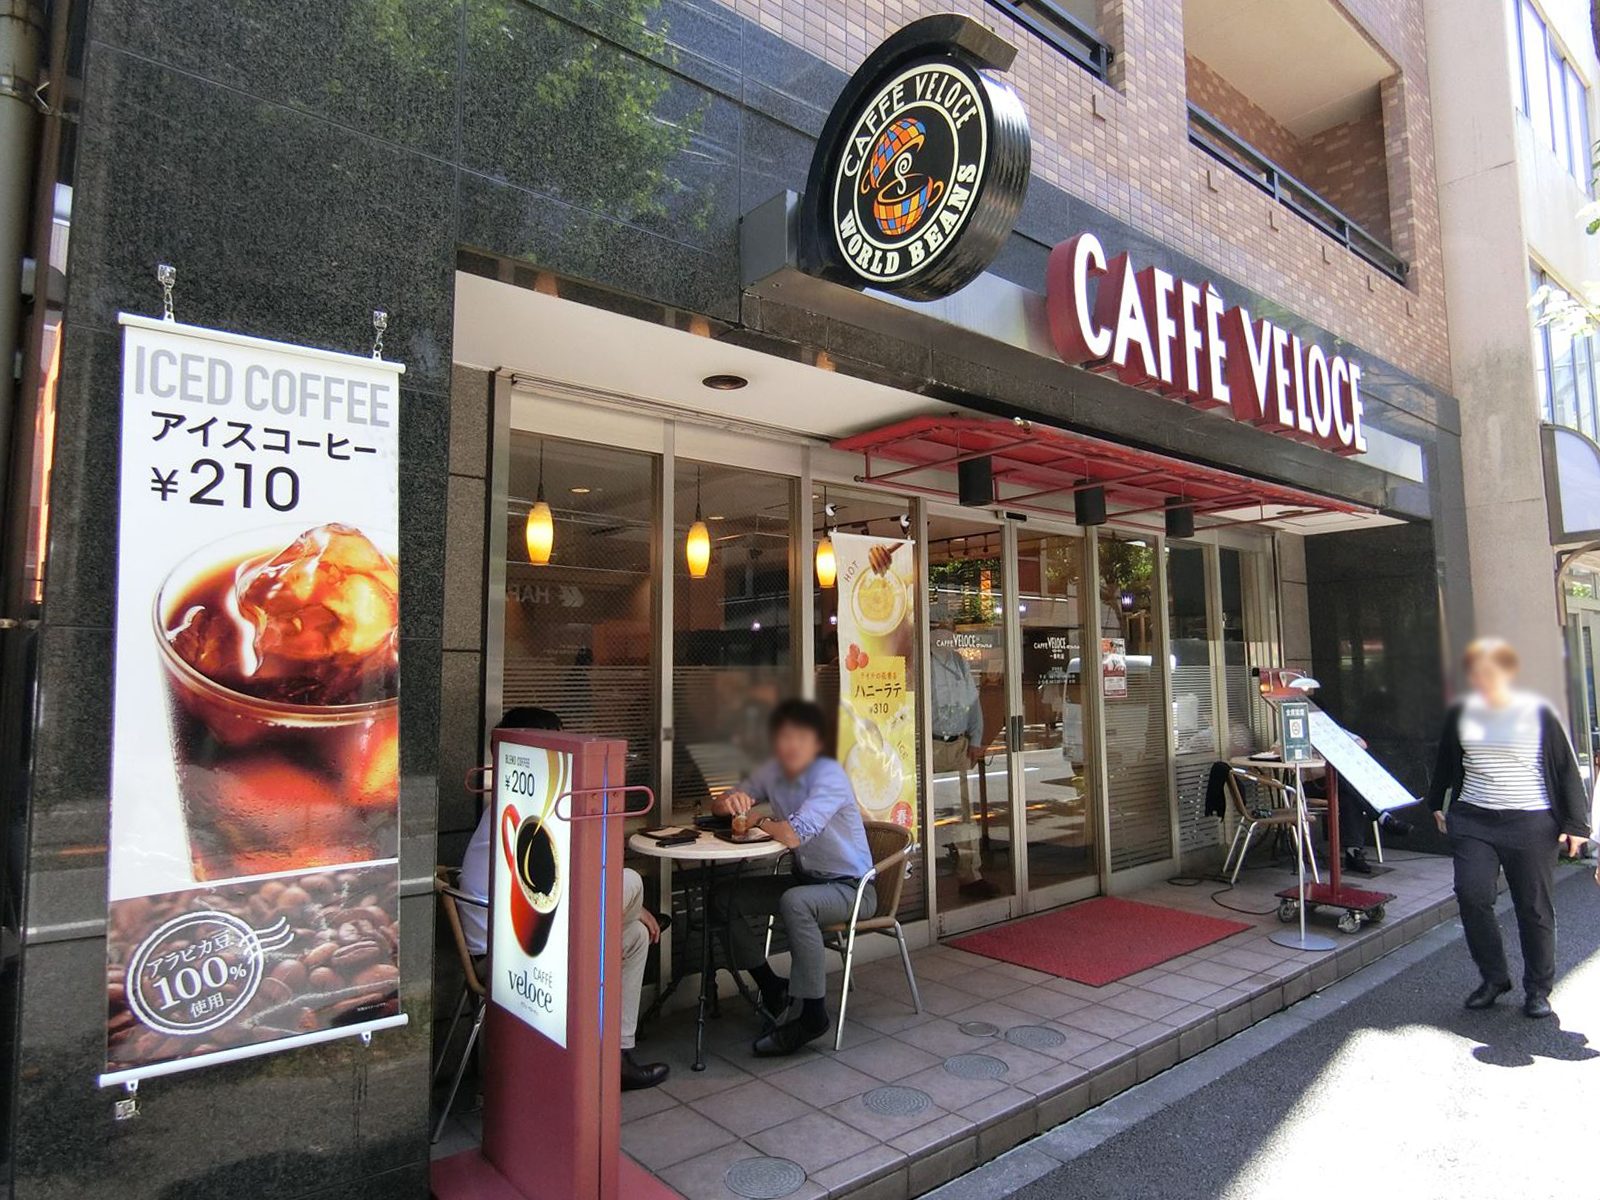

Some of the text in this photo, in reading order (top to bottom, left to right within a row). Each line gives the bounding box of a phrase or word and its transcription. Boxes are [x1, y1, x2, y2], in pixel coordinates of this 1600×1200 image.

[915, 72, 977, 130] VELOCE
[839, 163, 977, 275] WORLD BEANS
[1073, 232, 1368, 453] CAFFÈ VELOCE
[134, 345, 391, 428] ICED COFFEE
[150, 410, 377, 461] アイスコーヒー
[150, 458, 301, 512] ¥210
[843, 560, 859, 583] HOT
[855, 683, 902, 699] ハニーラテ
[505, 769, 536, 798] ¥200
[147, 929, 235, 979] アラビカ豆
[152, 956, 247, 1011] 100%
[191, 992, 224, 1018] 使用
[508, 970, 555, 1013] veloce
